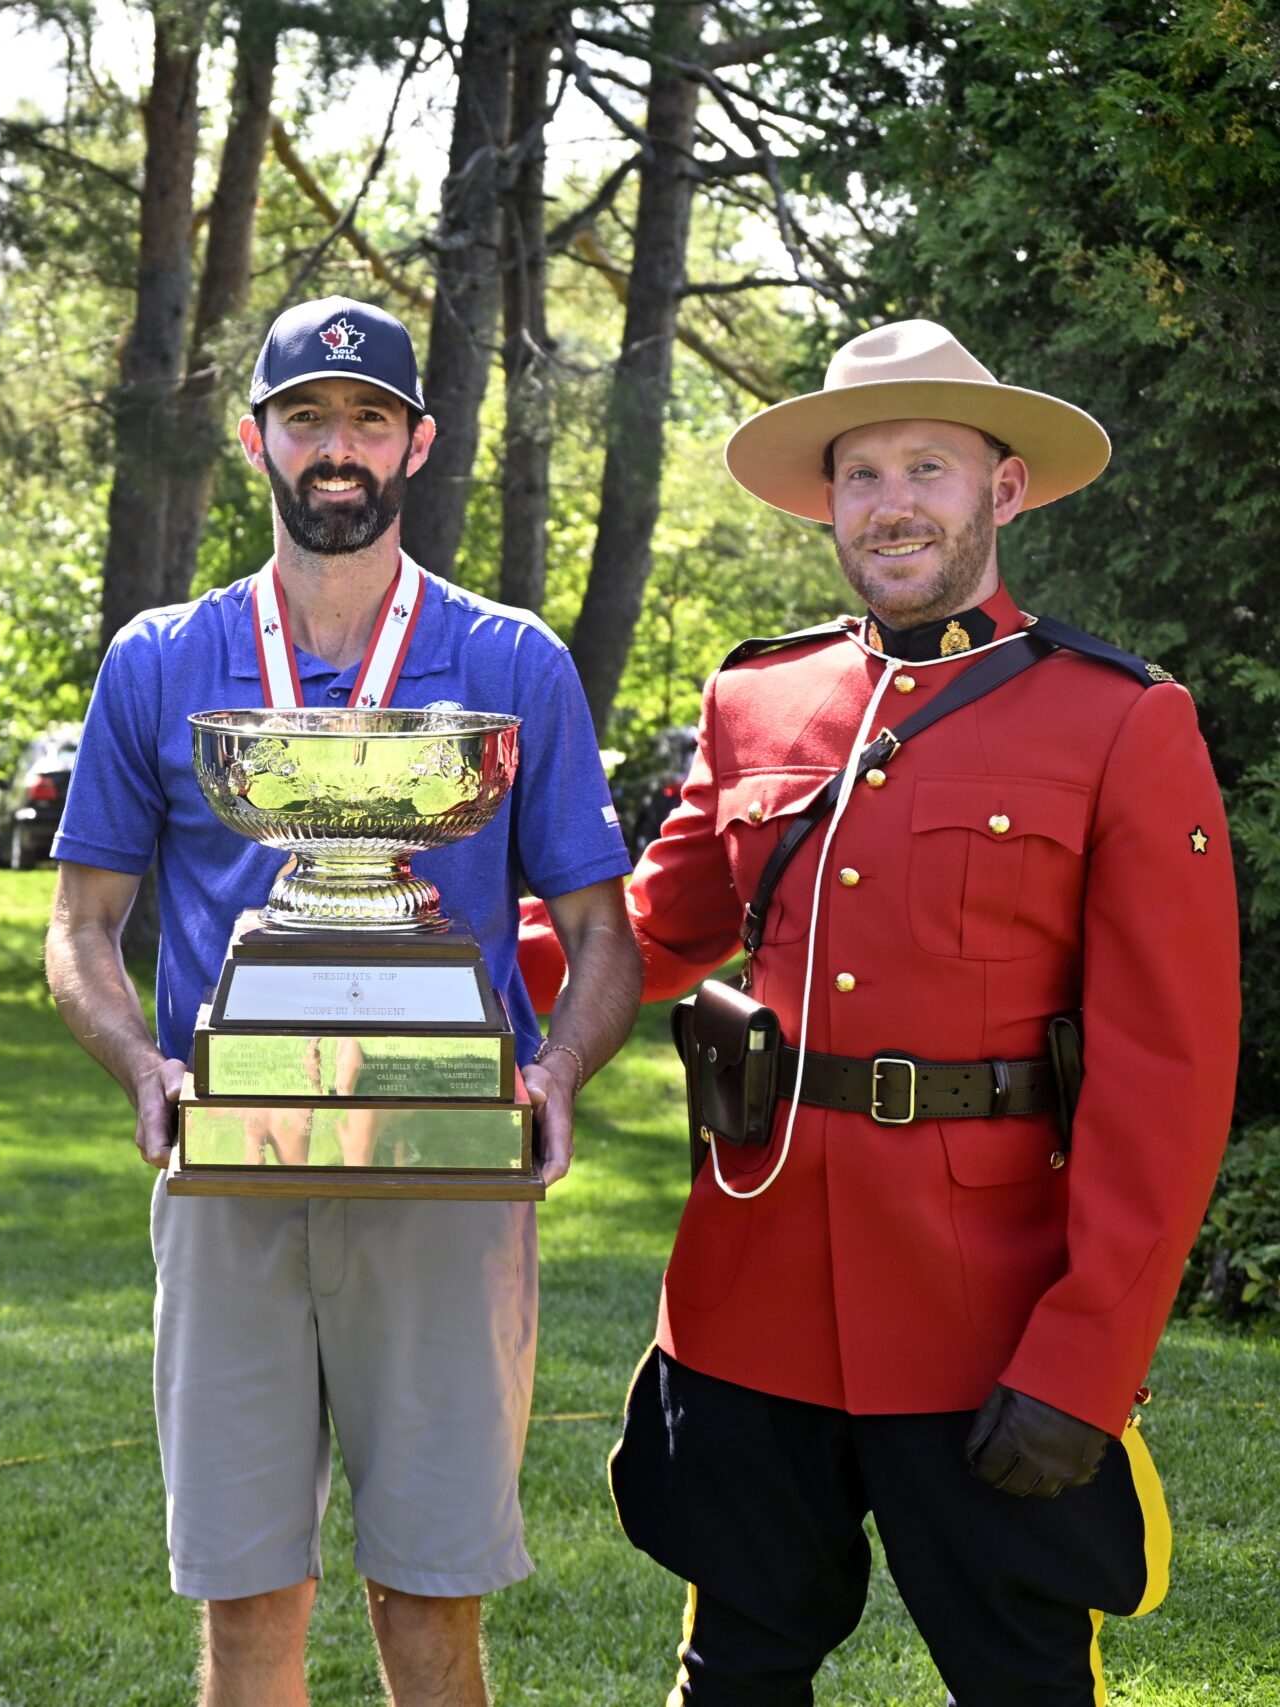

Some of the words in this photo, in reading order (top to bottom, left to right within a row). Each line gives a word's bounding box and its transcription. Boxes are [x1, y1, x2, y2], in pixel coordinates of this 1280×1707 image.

[325, 354, 362, 362] CANADA
[312, 972, 372, 981] PRESIDENTS
[379, 972, 398, 981] CUP
[303, 1006, 333, 1015] COUPE
[353, 1007, 406, 1016] PRESIDENT
